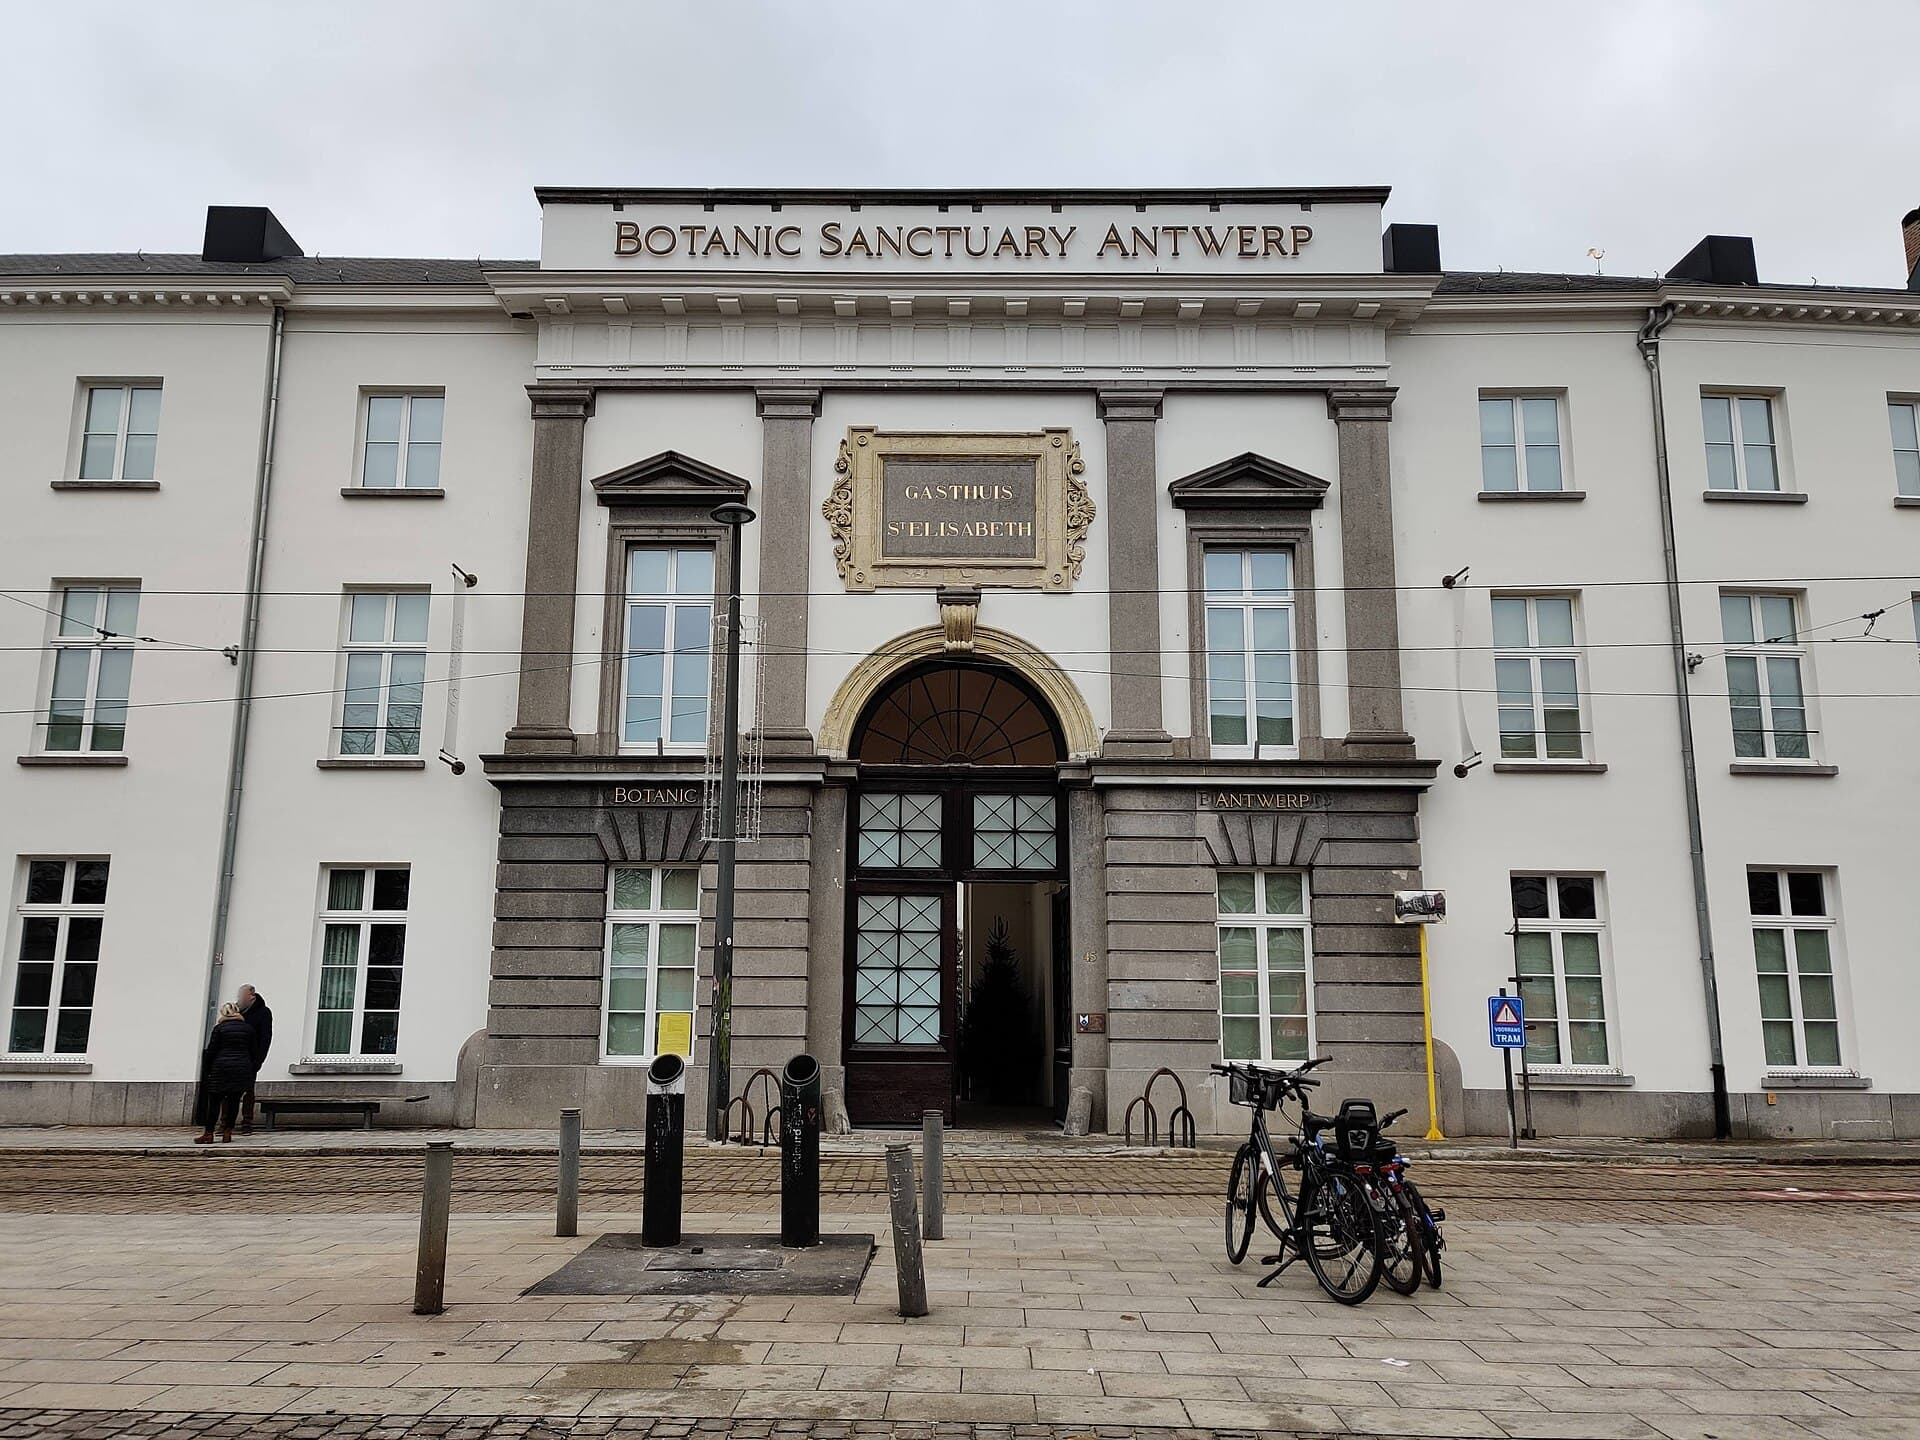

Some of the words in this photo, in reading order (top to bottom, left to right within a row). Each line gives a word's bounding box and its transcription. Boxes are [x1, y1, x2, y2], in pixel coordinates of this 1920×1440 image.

[613, 221, 801, 257] BOTANIC
[819, 222, 1077, 257] SANCTUARY
[1096, 223, 1314, 257] ANTWERP
[905, 485, 1013, 500] GASTHUIS
[614, 787, 697, 803] BOTANIC
[1215, 792, 1310, 808] ANTWERP
[1082, 952, 1097, 963] 45
[1496, 1034, 1521, 1043] TRAM
